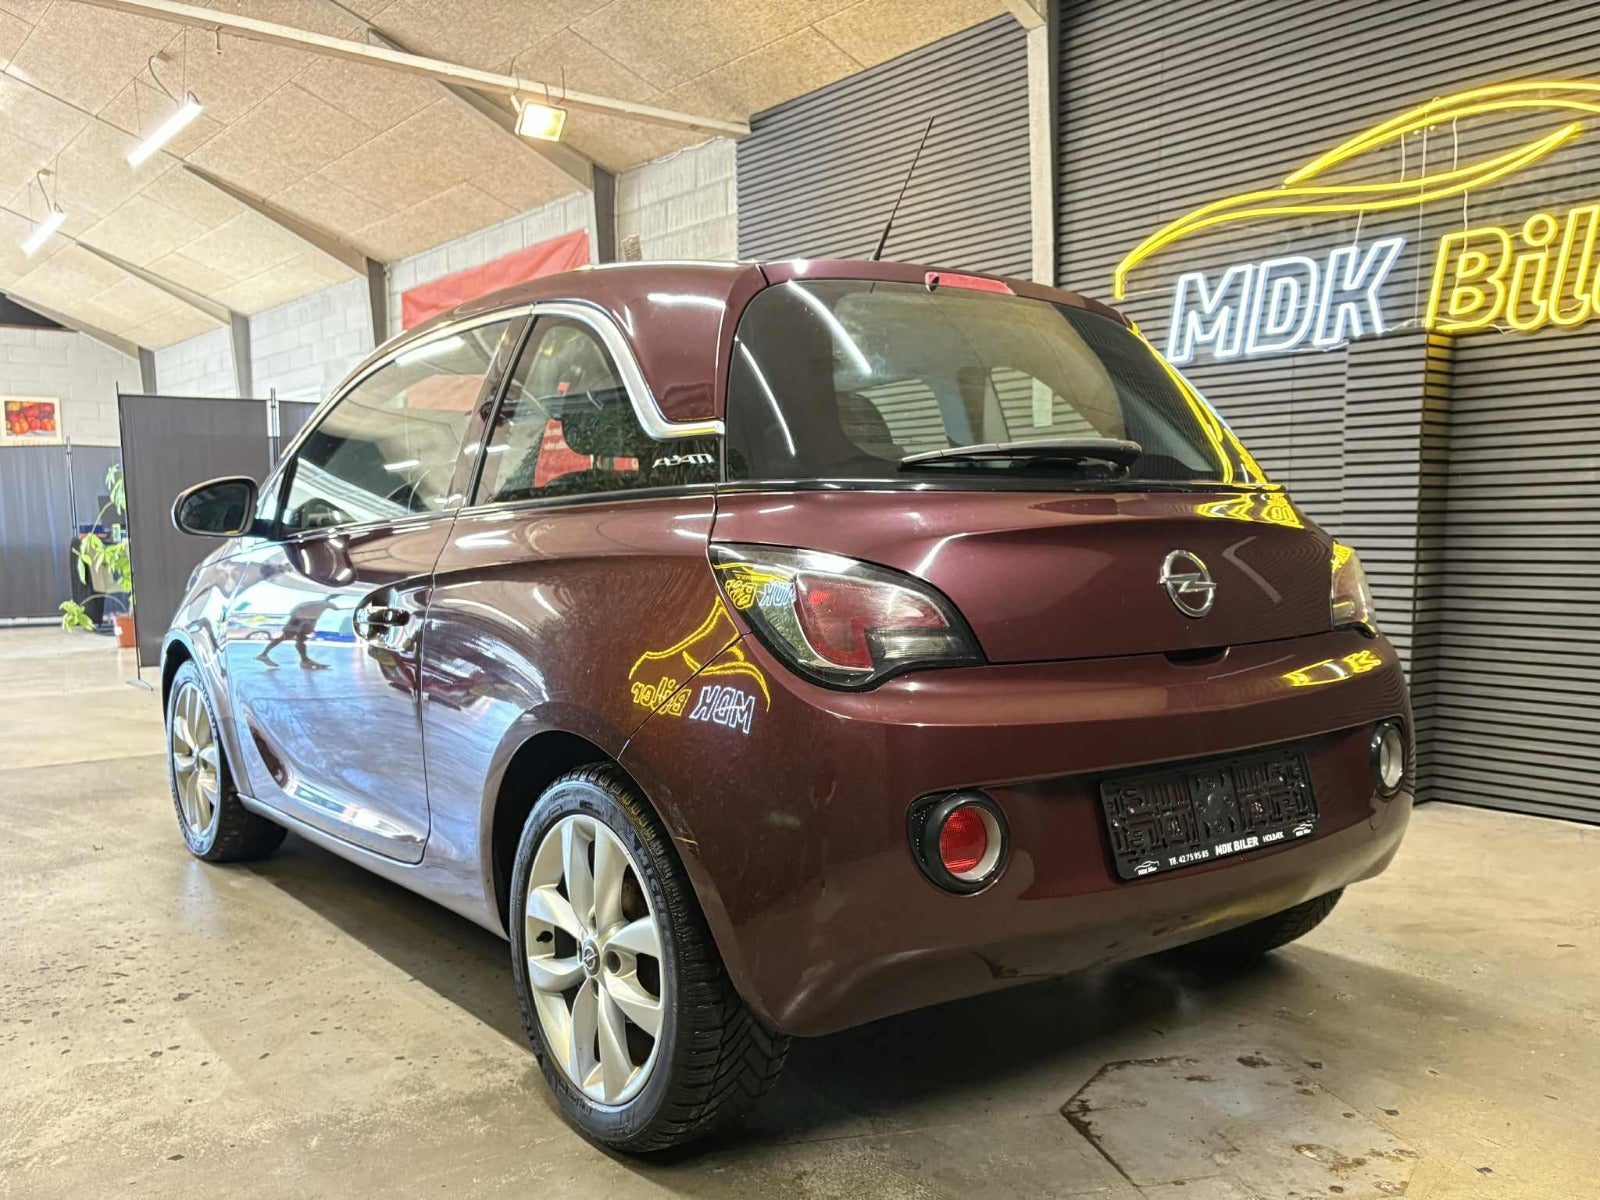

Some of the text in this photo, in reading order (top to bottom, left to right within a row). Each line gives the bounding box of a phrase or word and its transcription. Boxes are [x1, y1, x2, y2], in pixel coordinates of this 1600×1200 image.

[1167, 204, 1600, 363] MDK Bil
[1215, 841, 1233, 856] MDK
[1233, 836, 1259, 851] BILER
